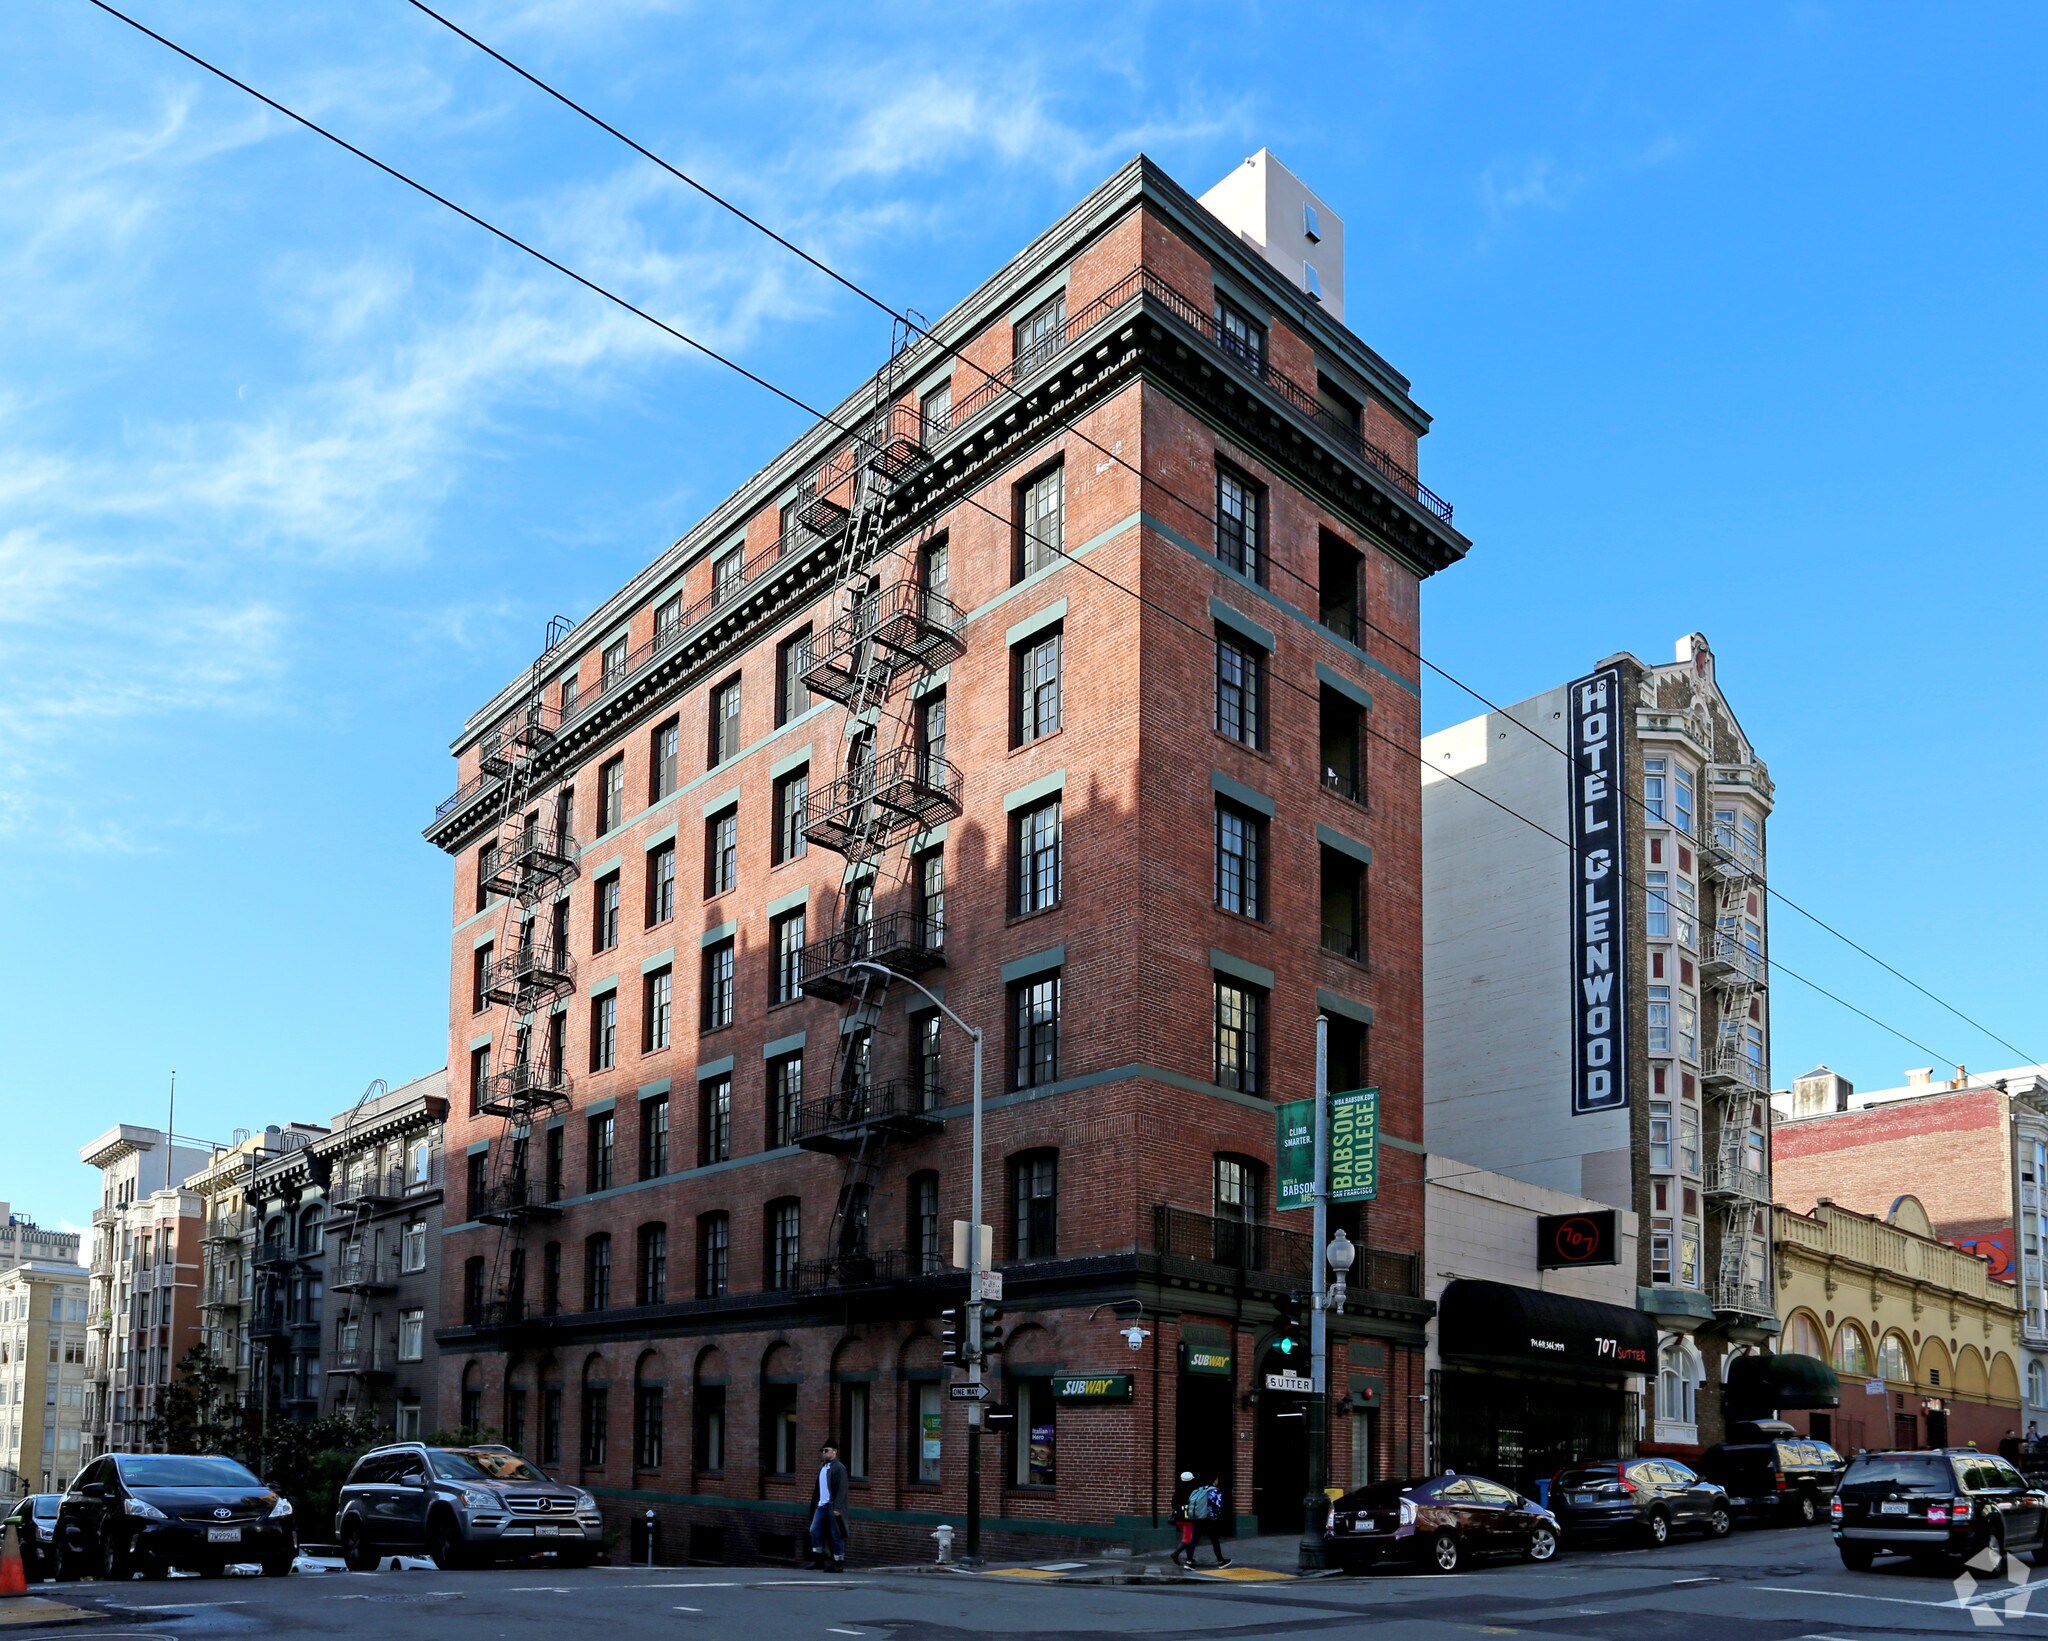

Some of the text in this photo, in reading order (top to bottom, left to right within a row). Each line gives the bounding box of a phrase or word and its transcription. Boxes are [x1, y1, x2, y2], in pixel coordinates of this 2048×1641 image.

[1581, 678, 1613, 1100] HOTEL GLENWOOD
[1334, 1093, 1375, 1106] MBA.BABSON.EDU
[1289, 1126, 1307, 1137] CLIMB
[1284, 1136, 1313, 1148] SMARTER.
[1332, 1103, 1354, 1190] BABSON
[1354, 1101, 1375, 1187] COLLEGE
[1282, 1181, 1316, 1197] BABSON
[1332, 1186, 1373, 1198] SAN FRANCISCO
[1561, 1227, 1594, 1252] 707
[1594, 1337, 1646, 1362] 707 SUTTER
[1190, 1353, 1230, 1368] SUBWAY
[1062, 1379, 1114, 1396] SUBWAY
[1270, 1377, 1310, 1390] SUTTER
[953, 1388, 979, 1396] ONE WAY
